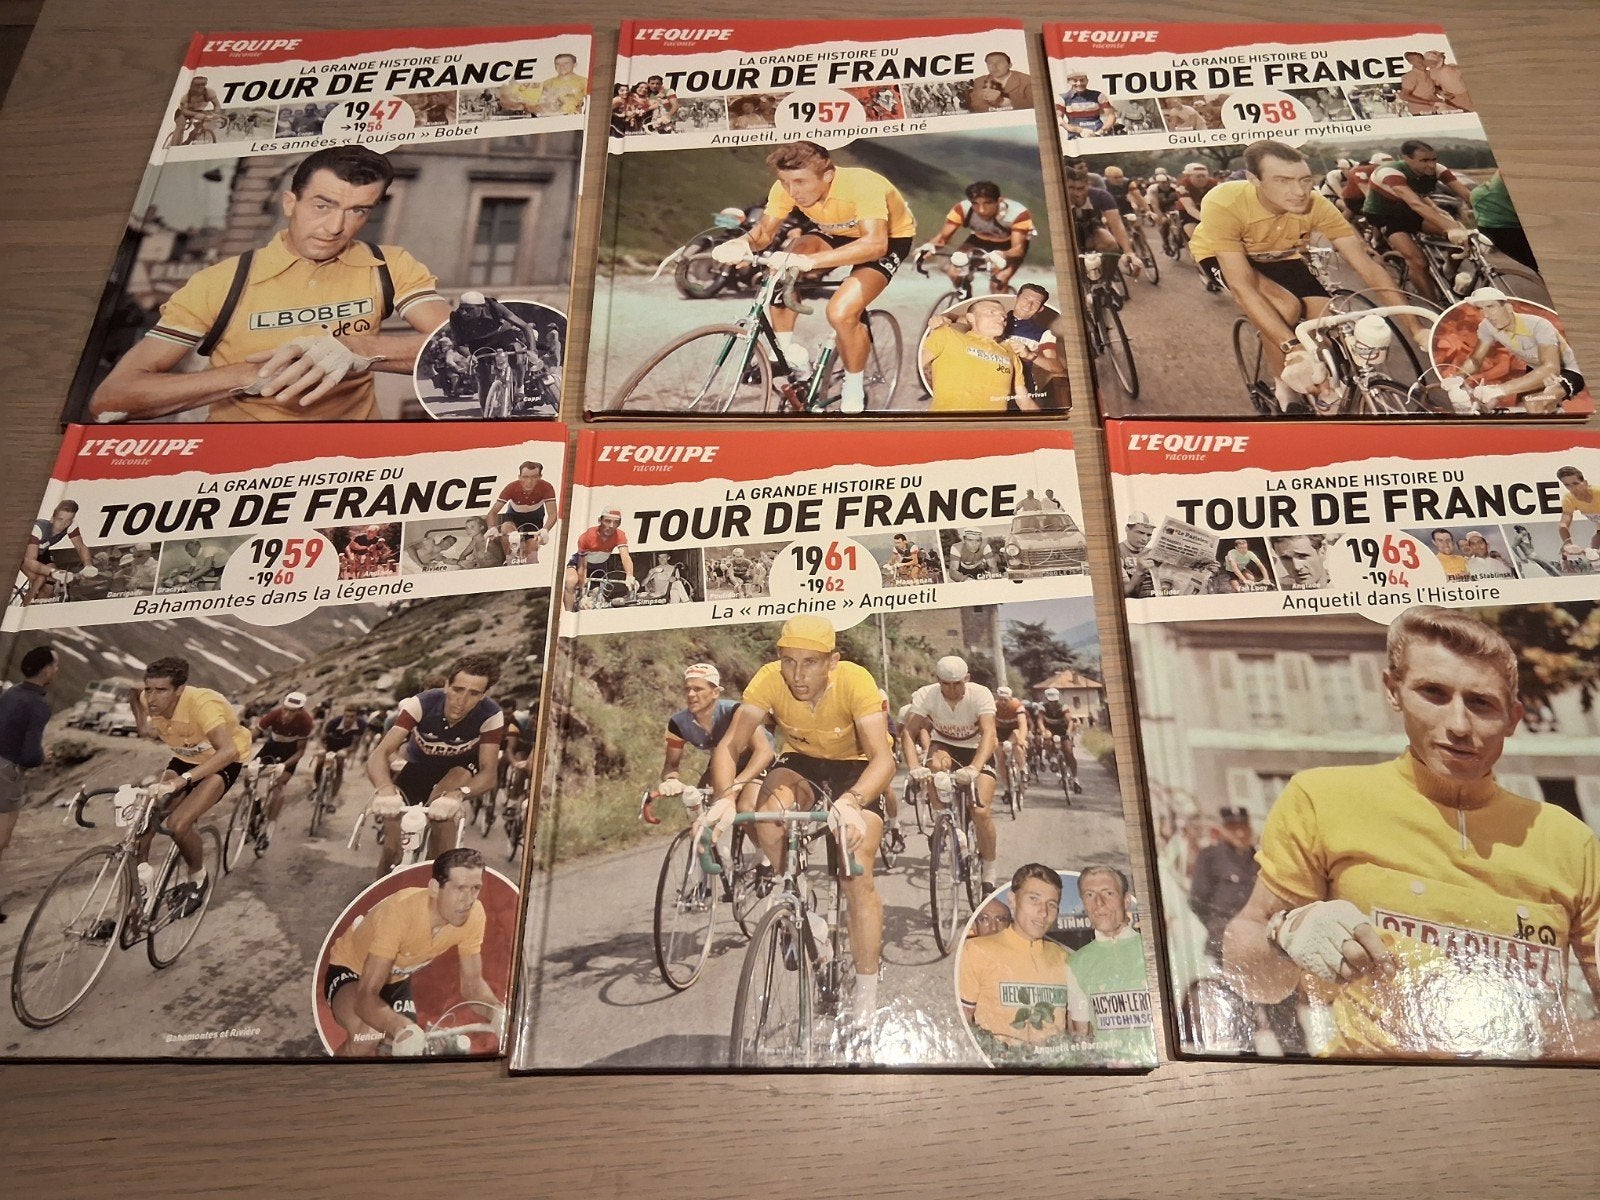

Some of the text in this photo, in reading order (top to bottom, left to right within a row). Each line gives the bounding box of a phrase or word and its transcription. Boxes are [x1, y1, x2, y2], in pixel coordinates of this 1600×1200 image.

[300, 54, 463, 75] LA GRANDE HISTOIRE DU
[739, 48, 899, 66] LA GRANDE HISTOIRE DU
[1172, 50, 1328, 68] LA GRANDE HISTOIRE DU
[221, 58, 538, 104] TOUR DE FRANCE
[664, 52, 975, 93] TOUR DE FRANCE
[1102, 56, 1408, 96] TOUR DE FRANCE
[344, 100, 403, 121] 1947
[788, 101, 851, 123] 1957
[1232, 99, 1297, 124] 1958
[250, 142, 277, 152] Les
[282, 138, 336, 150] années
[356, 131, 415, 144] Louison
[435, 125, 479, 138] Bobet
[711, 122, 927, 146] Anquetil, un champion est né
[1168, 123, 1372, 144] Gaul, ce grimpeur mythique
[110, 457, 152, 466] raconte
[632, 464, 673, 472] raconte
[1165, 453, 1206, 461] raconte
[198, 467, 405, 494] LA GRANDE HISTOIRE DU
[725, 475, 922, 501] LA GRANDE HISTOIRE DU
[1266, 470, 1465, 491] LA GRANDE HISTOIRE DU
[98, 475, 497, 538] TOUR DE FRANCE
[633, 483, 1017, 544] TOUR DE FRANCE
[1176, 481, 1563, 531] TOUR DE FRANCE
[250, 538, 324, 569] 1959
[791, 541, 857, 575] 1961
[1346, 534, 1420, 570] 1963
[106, 590, 144, 598] Darrigade
[132, 579, 414, 616] Bahamontes dans la légende
[711, 604, 733, 620] La
[758, 597, 836, 616] machine
[859, 589, 937, 610] Anquetil
[1282, 584, 1500, 612] Anquetil dans l'Histoire
[165, 1033, 218, 1043] Bahamontes
[219, 1030, 229, 1038] et
[353, 1031, 386, 1042] Nencini
